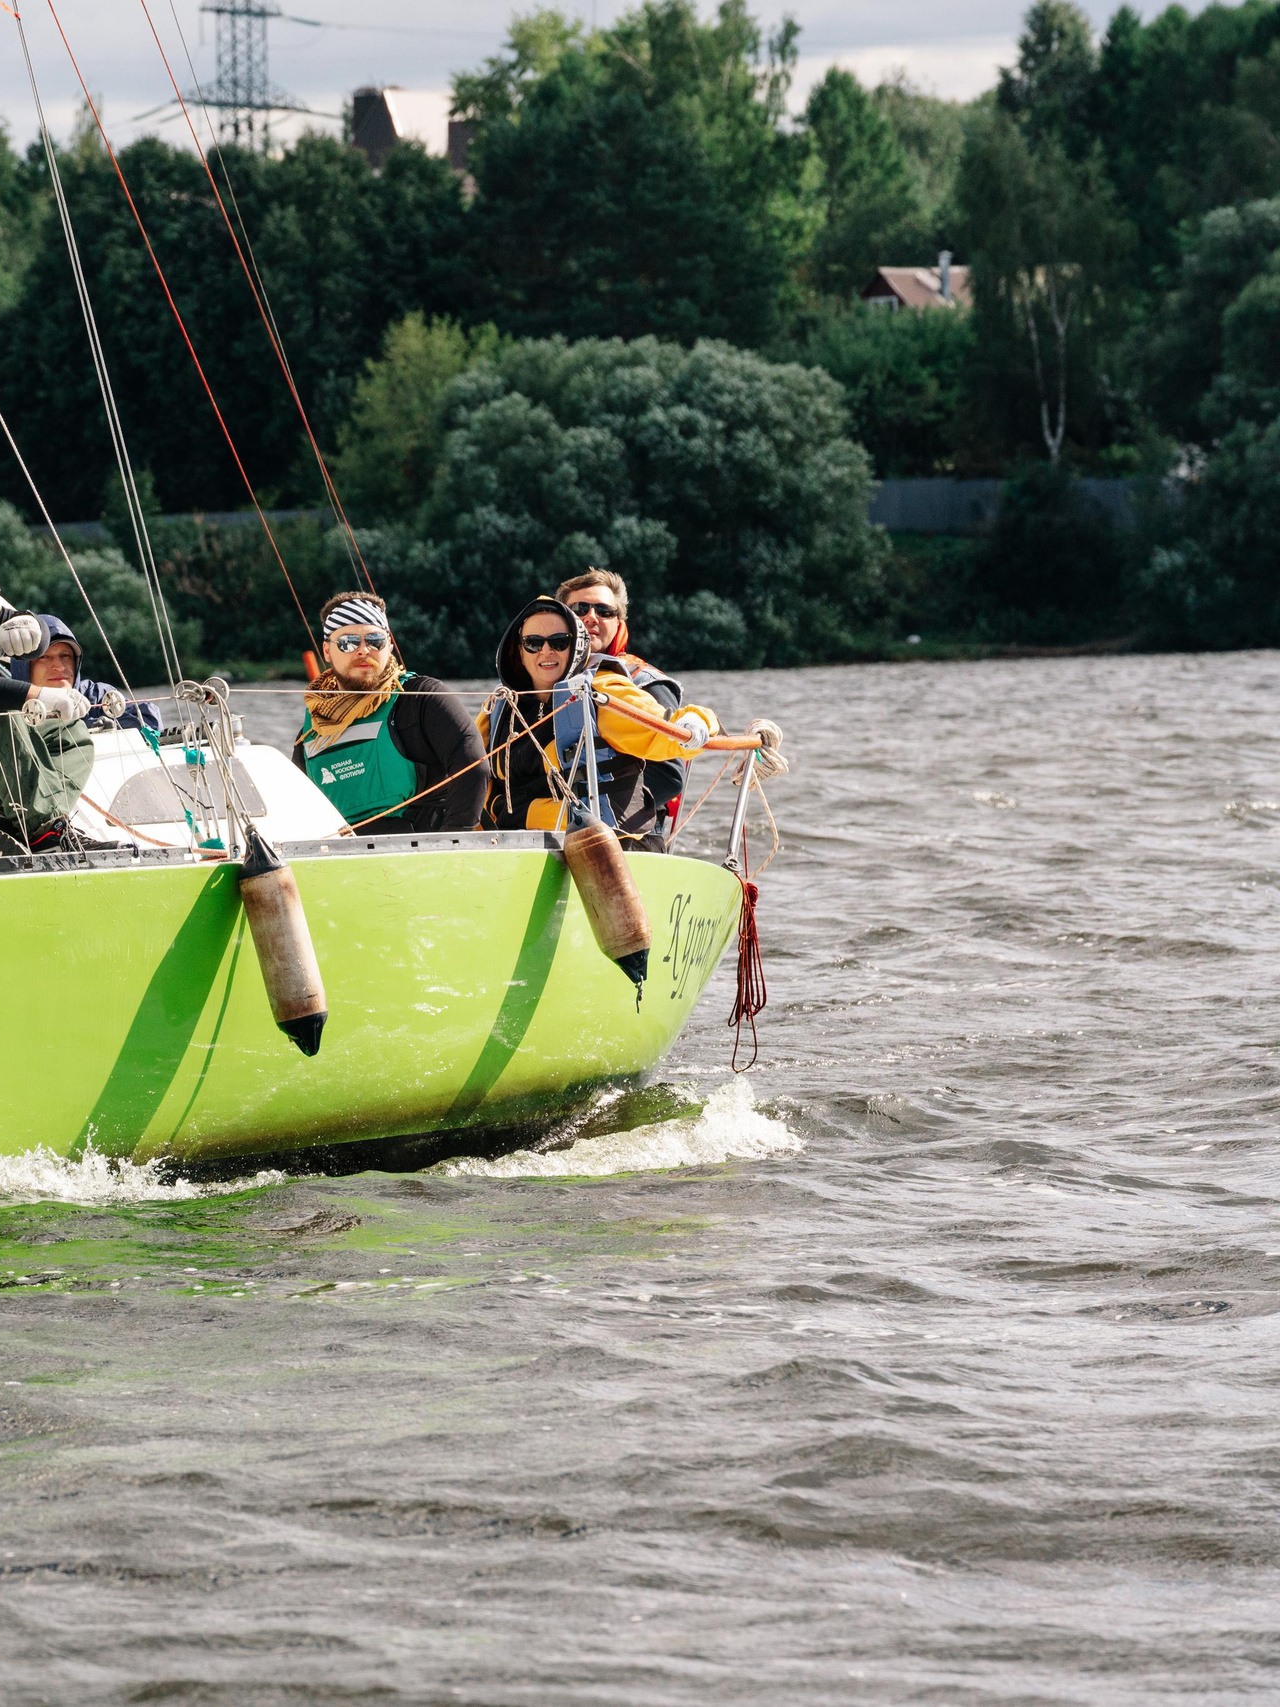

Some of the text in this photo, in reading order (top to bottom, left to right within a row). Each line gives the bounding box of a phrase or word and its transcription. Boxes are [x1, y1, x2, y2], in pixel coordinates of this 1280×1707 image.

[331, 759, 352, 770] ВОЛЬНАЯ
[335, 762, 364, 774] МОСКОВСКАЯ
[339, 768, 366, 780] ФЛОТИЛИЯ
